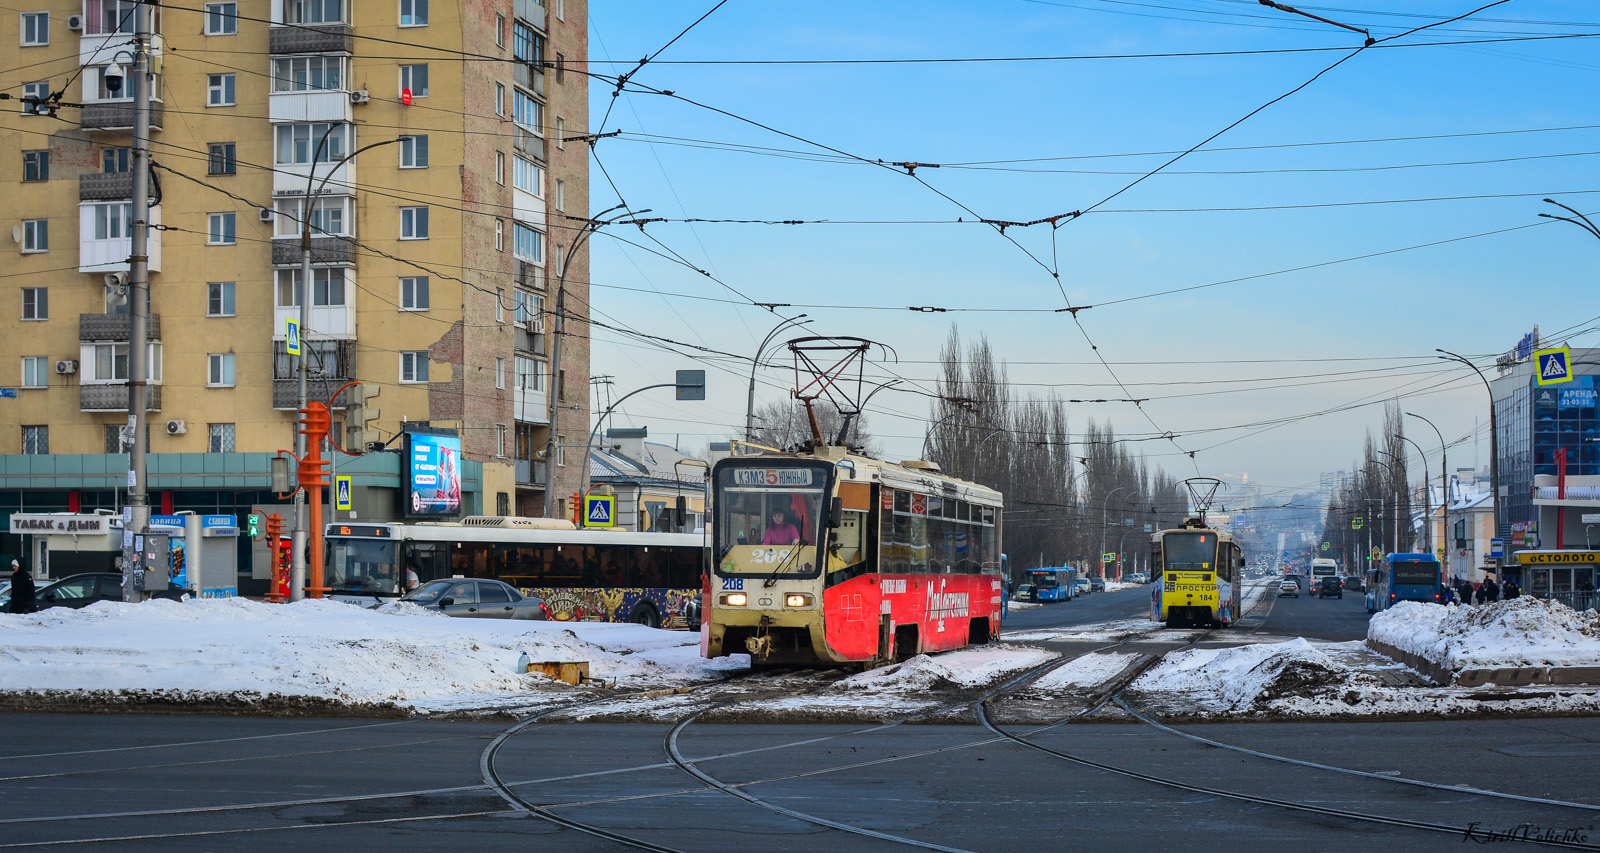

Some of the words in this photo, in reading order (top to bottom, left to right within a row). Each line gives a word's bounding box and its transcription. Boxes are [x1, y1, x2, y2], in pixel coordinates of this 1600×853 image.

[1564, 390, 1598, 398] АРЕНДА
[766, 470, 778, 484] 5
[779, 470, 808, 484] ЮЖНЫЙ
[14, 520, 54, 530] ТАБАК
[67, 520, 100, 532] ДЫМ
[250, 516, 258, 524] 29
[750, 548, 790, 564] 208
[1538, 554, 1595, 562] СТОЛОТО
[722, 578, 744, 590] 208
